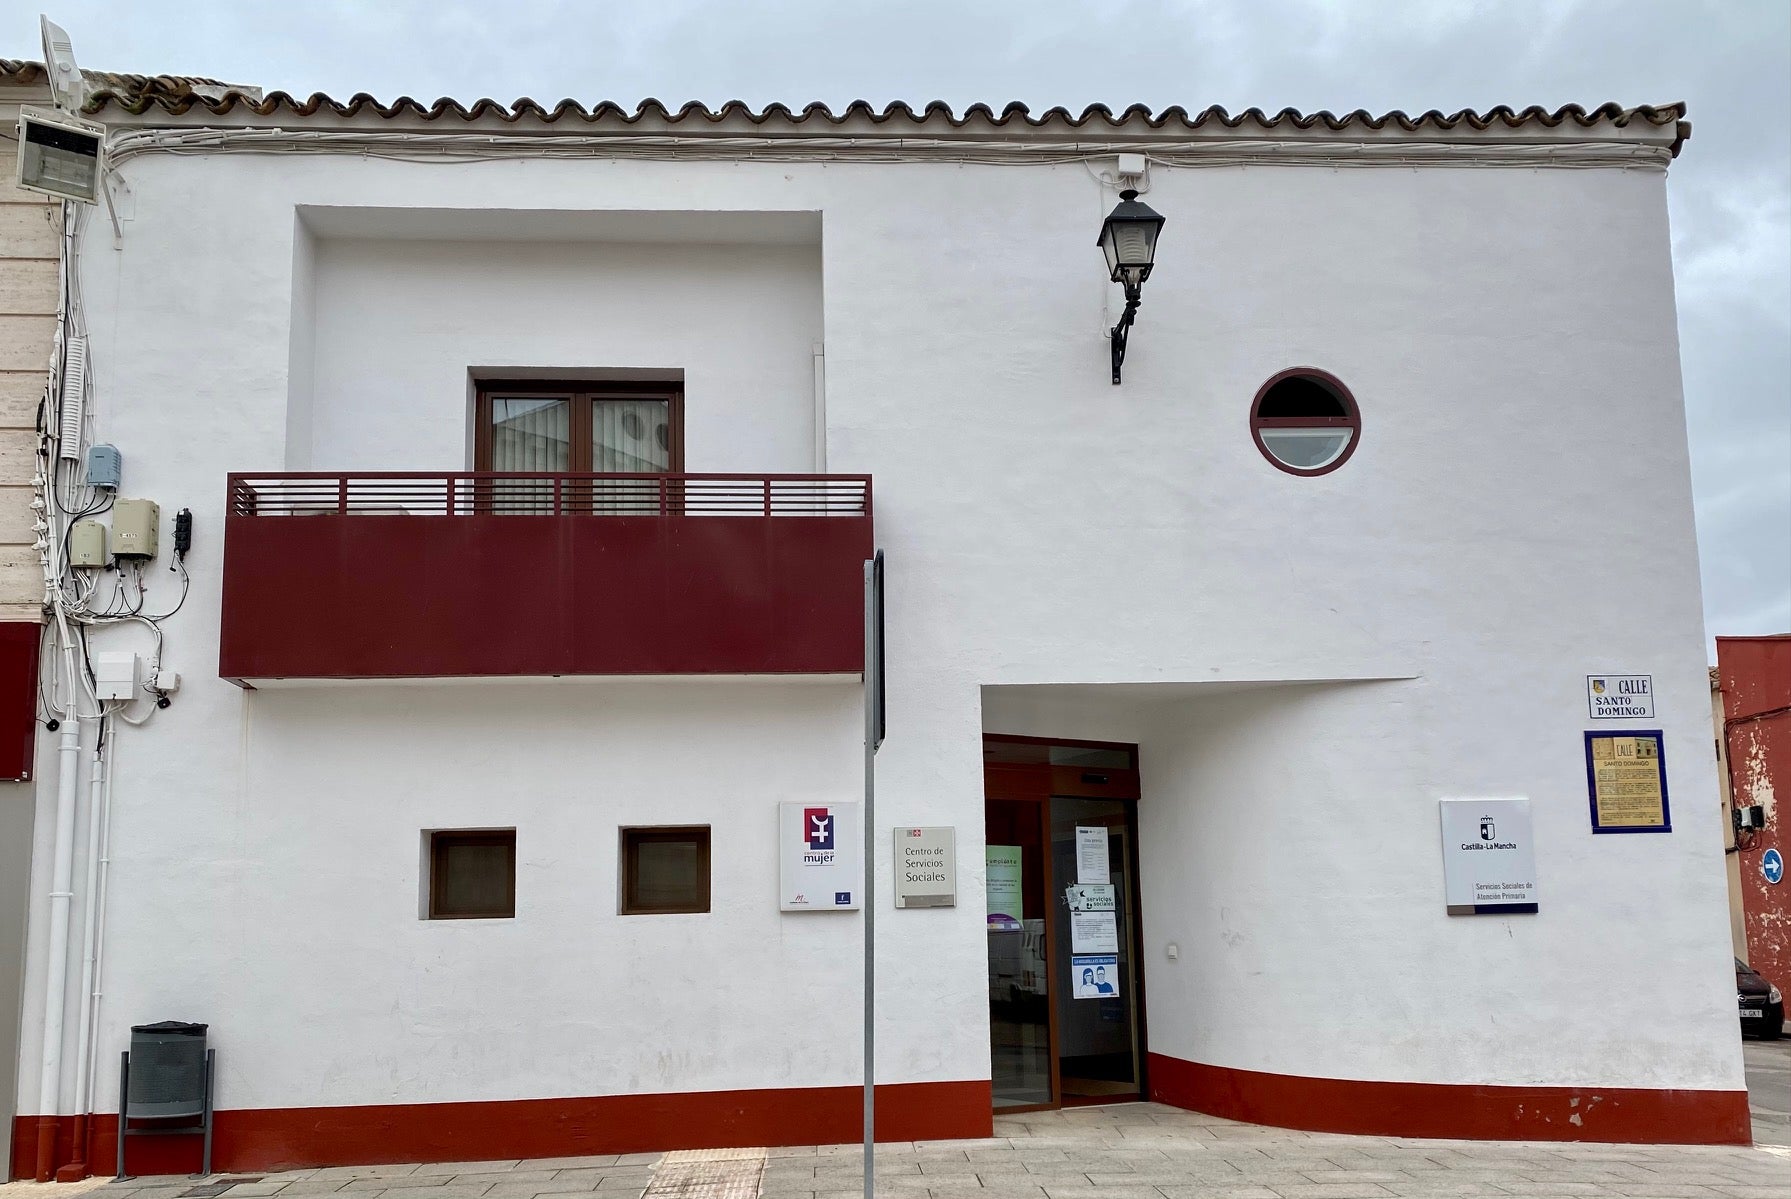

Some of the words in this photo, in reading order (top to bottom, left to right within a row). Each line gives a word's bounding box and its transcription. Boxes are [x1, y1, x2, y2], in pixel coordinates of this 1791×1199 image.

[1618, 679, 1648, 694] CALLE
[1595, 696, 1631, 706] SANTO
[1597, 706, 1646, 716] DOMINGO
[1616, 744, 1634, 757] CALLE
[905, 847, 932, 856] Centro
[933, 846, 944, 855] de
[1493, 842, 1517, 850] Mancha
[804, 853, 835, 865] mujer
[905, 859, 944, 868] Servicios
[905, 872, 946, 882] Sociales
[1501, 882, 1525, 890] Sociales
[1477, 892, 1501, 900] Atención
[1501, 892, 1526, 900] Primaria
